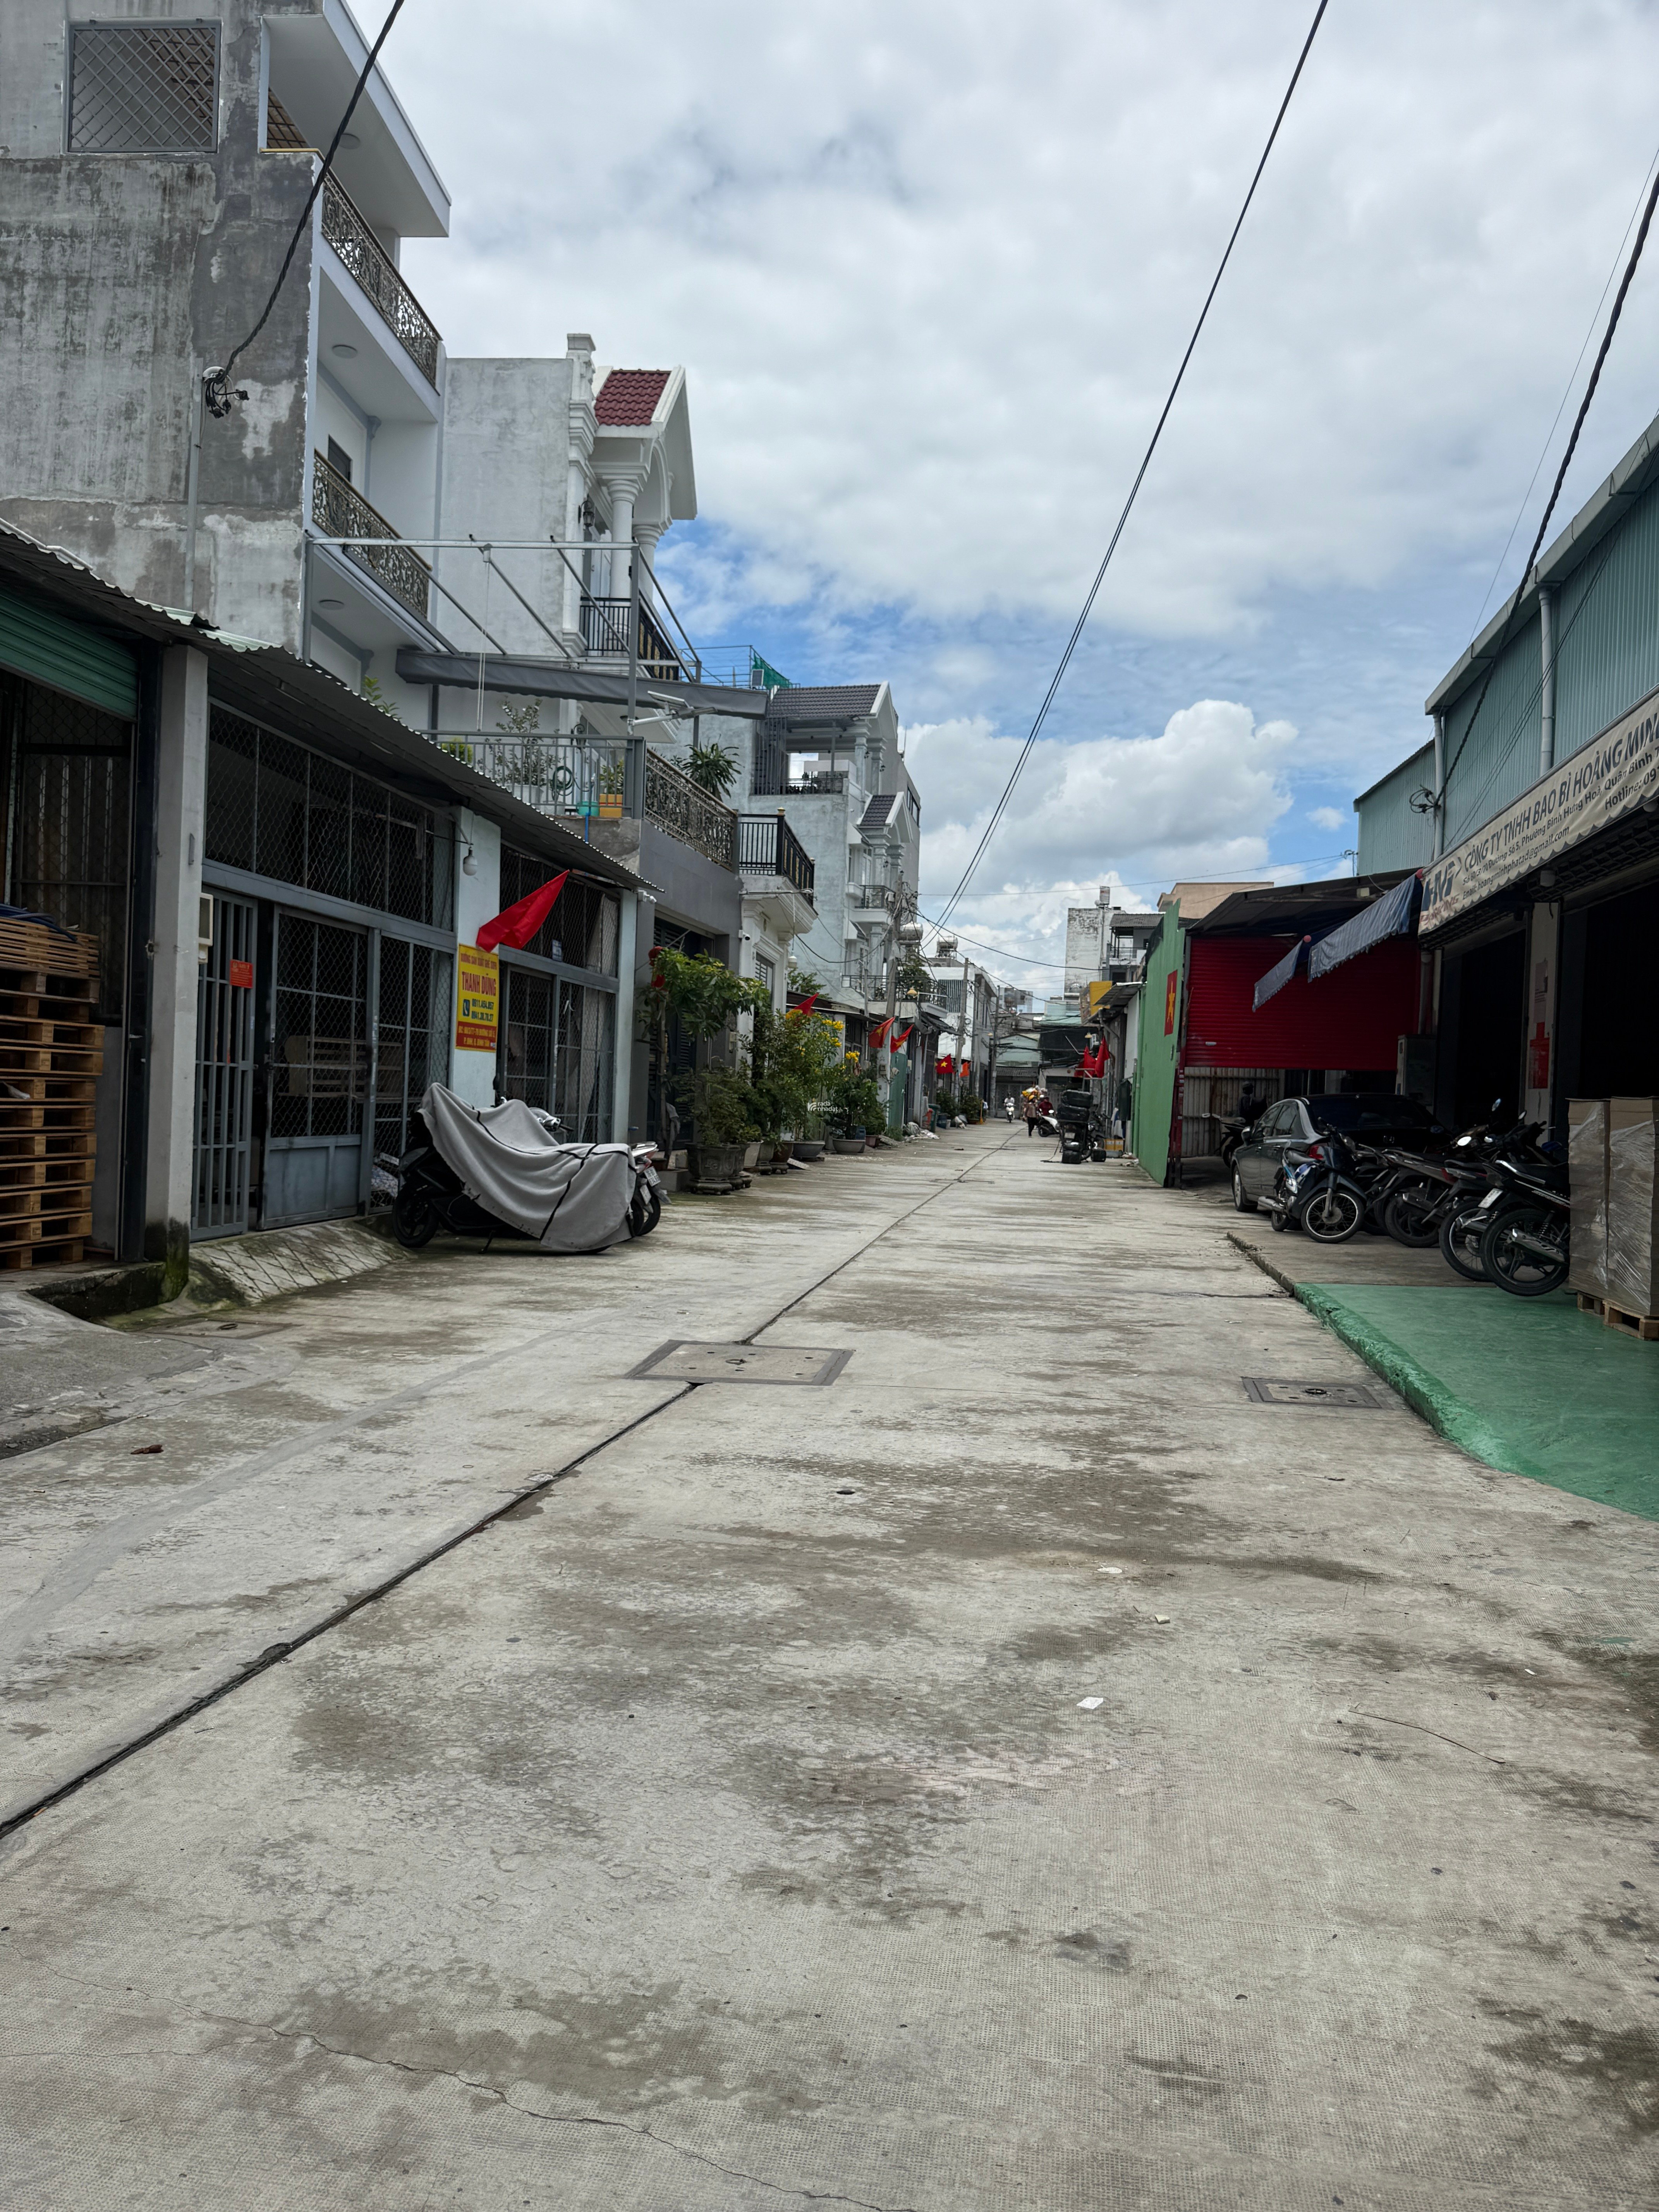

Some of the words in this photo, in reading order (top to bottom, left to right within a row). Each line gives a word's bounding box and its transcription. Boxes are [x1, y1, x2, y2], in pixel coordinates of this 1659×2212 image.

[1491, 828, 1503, 855] TY
[1504, 807, 1531, 846] TNHH
[1532, 789, 1556, 826] BAO
[1558, 772, 1571, 807] BÌ
[1573, 738, 1623, 797] HOÀNG
[1522, 825, 1546, 847] Phường
[1547, 813, 1562, 829] Bình
[1564, 800, 1583, 818] Hưng
[1629, 752, 1652, 774] Bình
[1605, 779, 1642, 810] Hotline:
